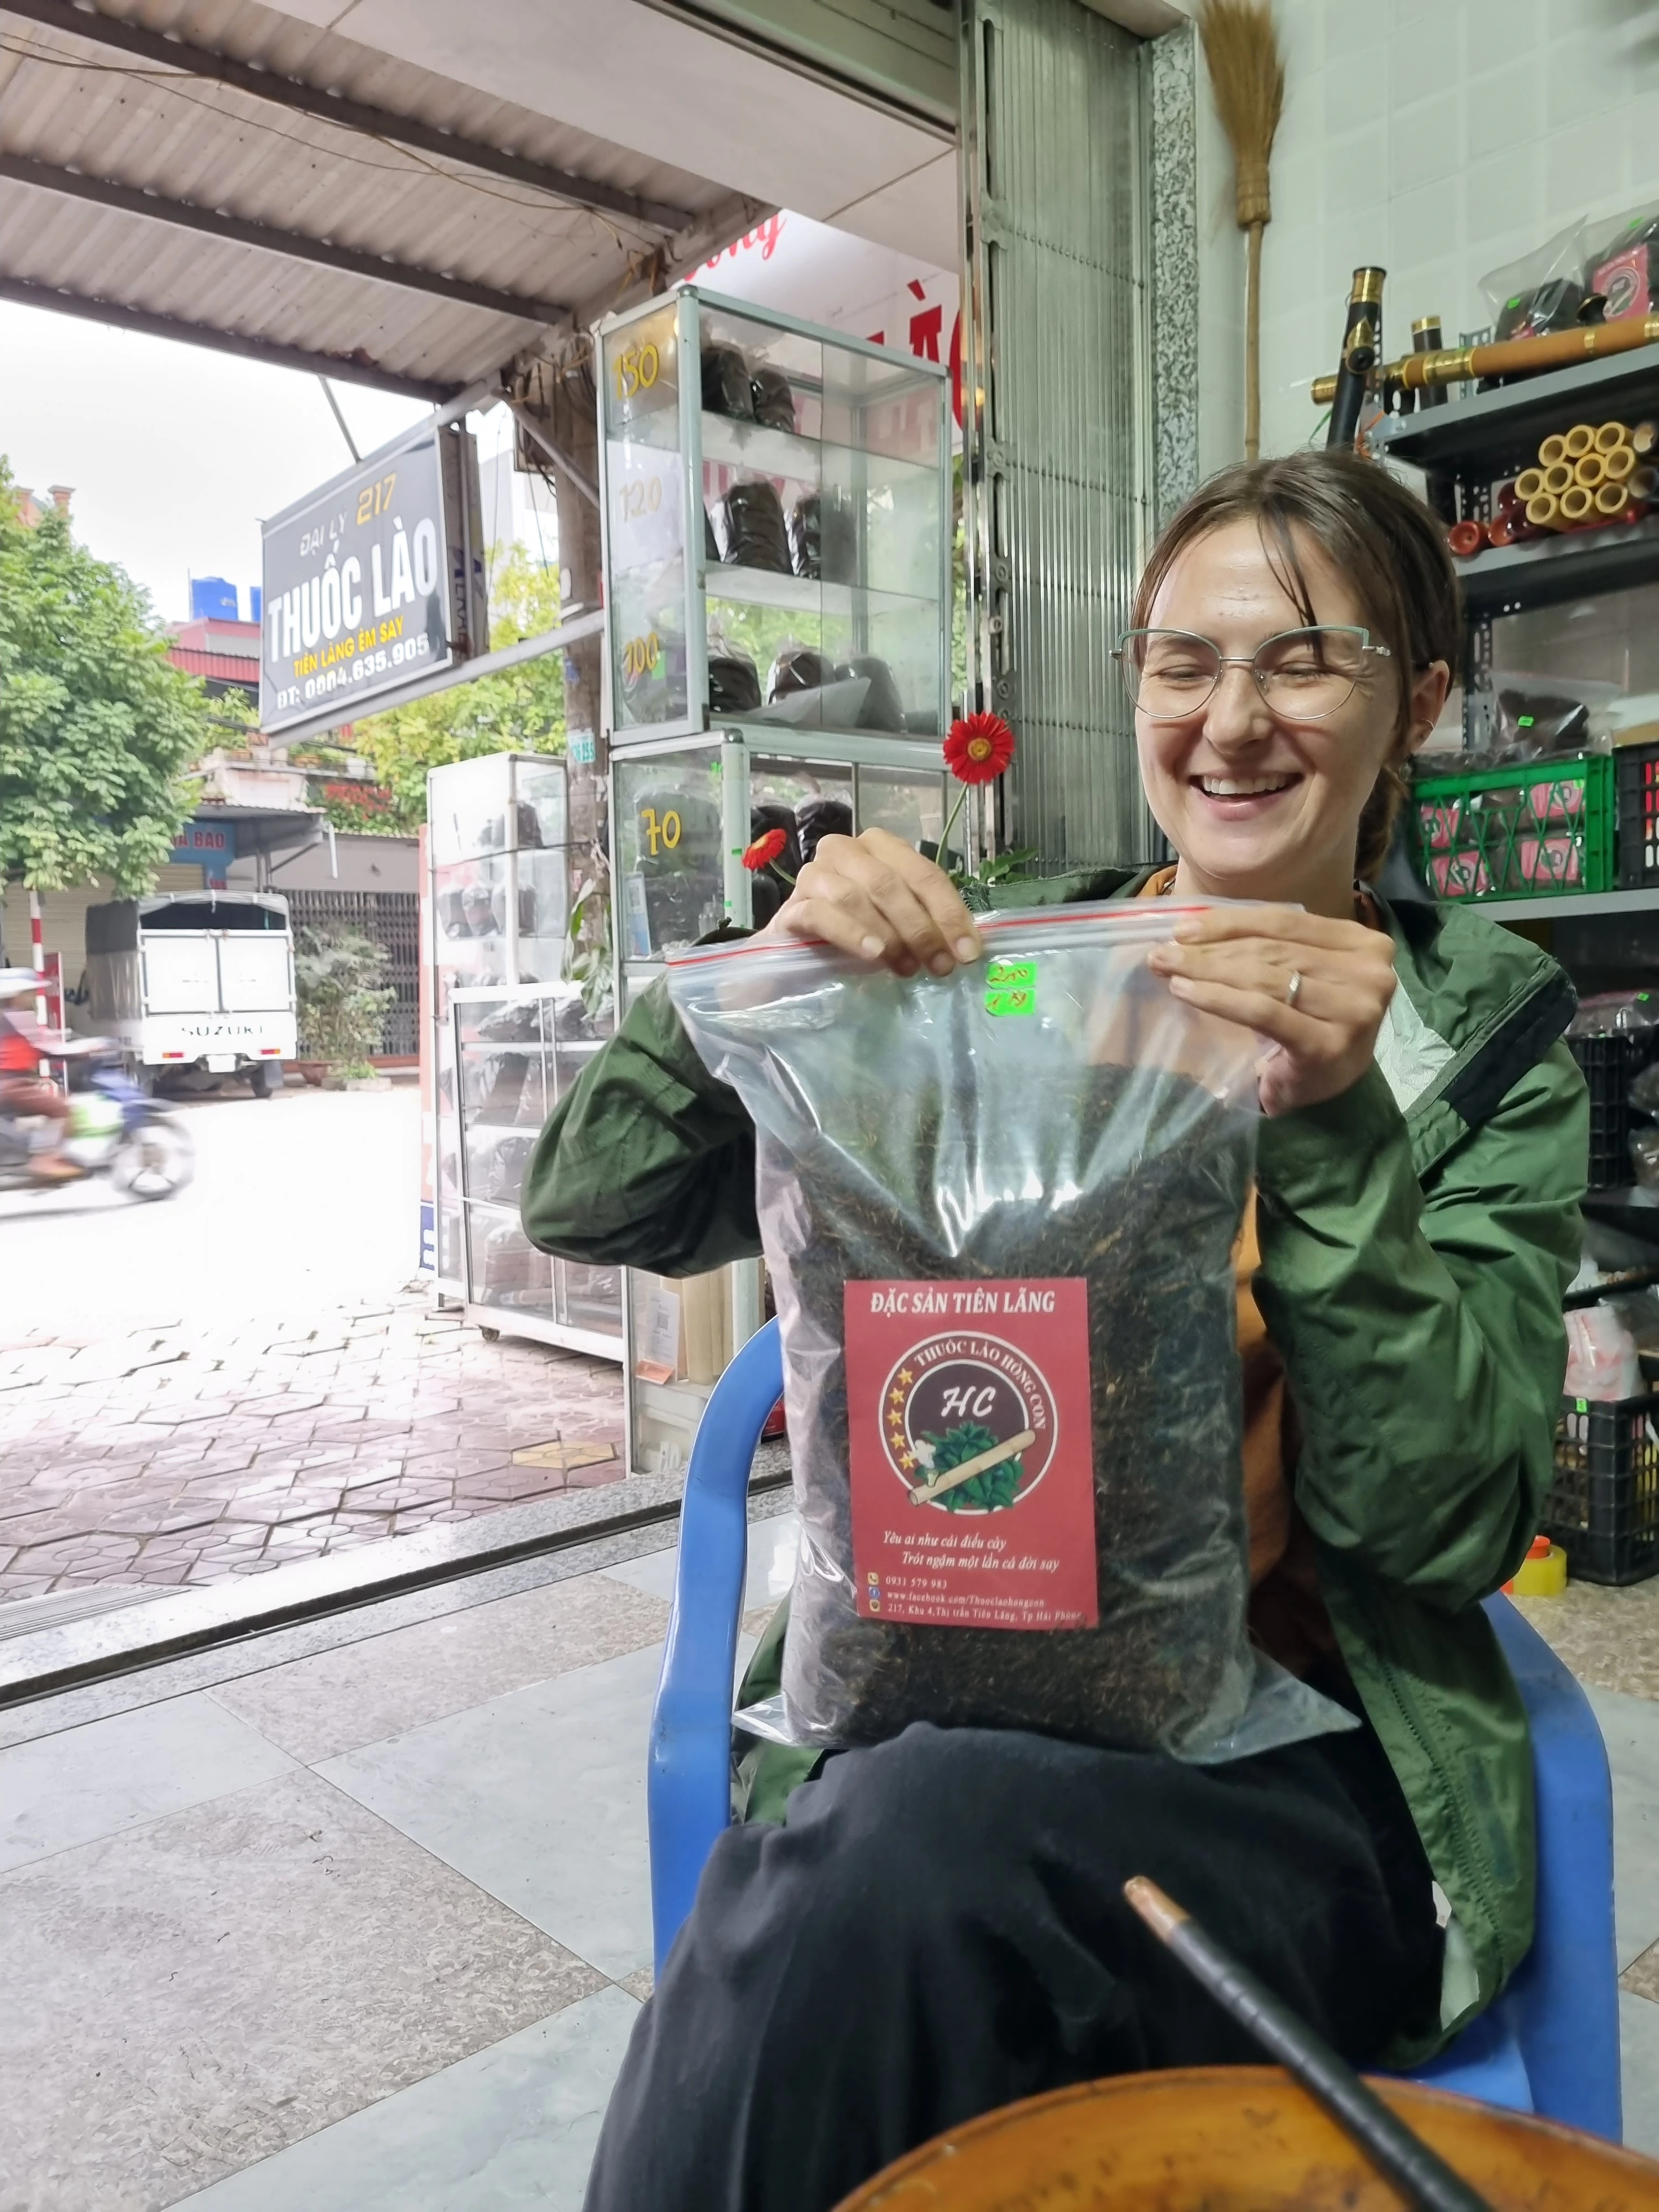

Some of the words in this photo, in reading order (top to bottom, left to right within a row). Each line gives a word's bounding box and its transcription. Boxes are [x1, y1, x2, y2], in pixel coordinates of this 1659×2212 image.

[612, 344, 659, 400] 150
[357, 471, 397, 526] 217
[620, 476, 662, 523] 120
[268, 538, 363, 662] THUỐC
[372, 514, 439, 618] LÀO
[293, 651, 318, 679] TIÊN
[358, 627, 376, 653] ÊM
[379, 615, 404, 645] SAY
[624, 632, 659, 675] 100
[641, 808, 681, 855] 70
[181, 1026, 262, 1036] SUZUKI
[870, 1287, 909, 1318] ĐẶC
[912, 1286, 948, 1313] SẢN
[953, 1286, 999, 1313] TIÊN
[941, 1385, 997, 1418] HC
[883, 1530, 902, 1545] Yêu
[904, 1533, 916, 1546] ai
[917, 1532, 939, 1547] như
[941, 1533, 958, 1548] cái
[885, 1576, 907, 1586] 0931
[911, 1578, 928, 1588] 579
[958, 1554, 979, 1570] một
[1040, 1559, 1060, 1574] say
[909, 1605, 925, 1615] Khu
[972, 1609, 992, 1620] Tiên
